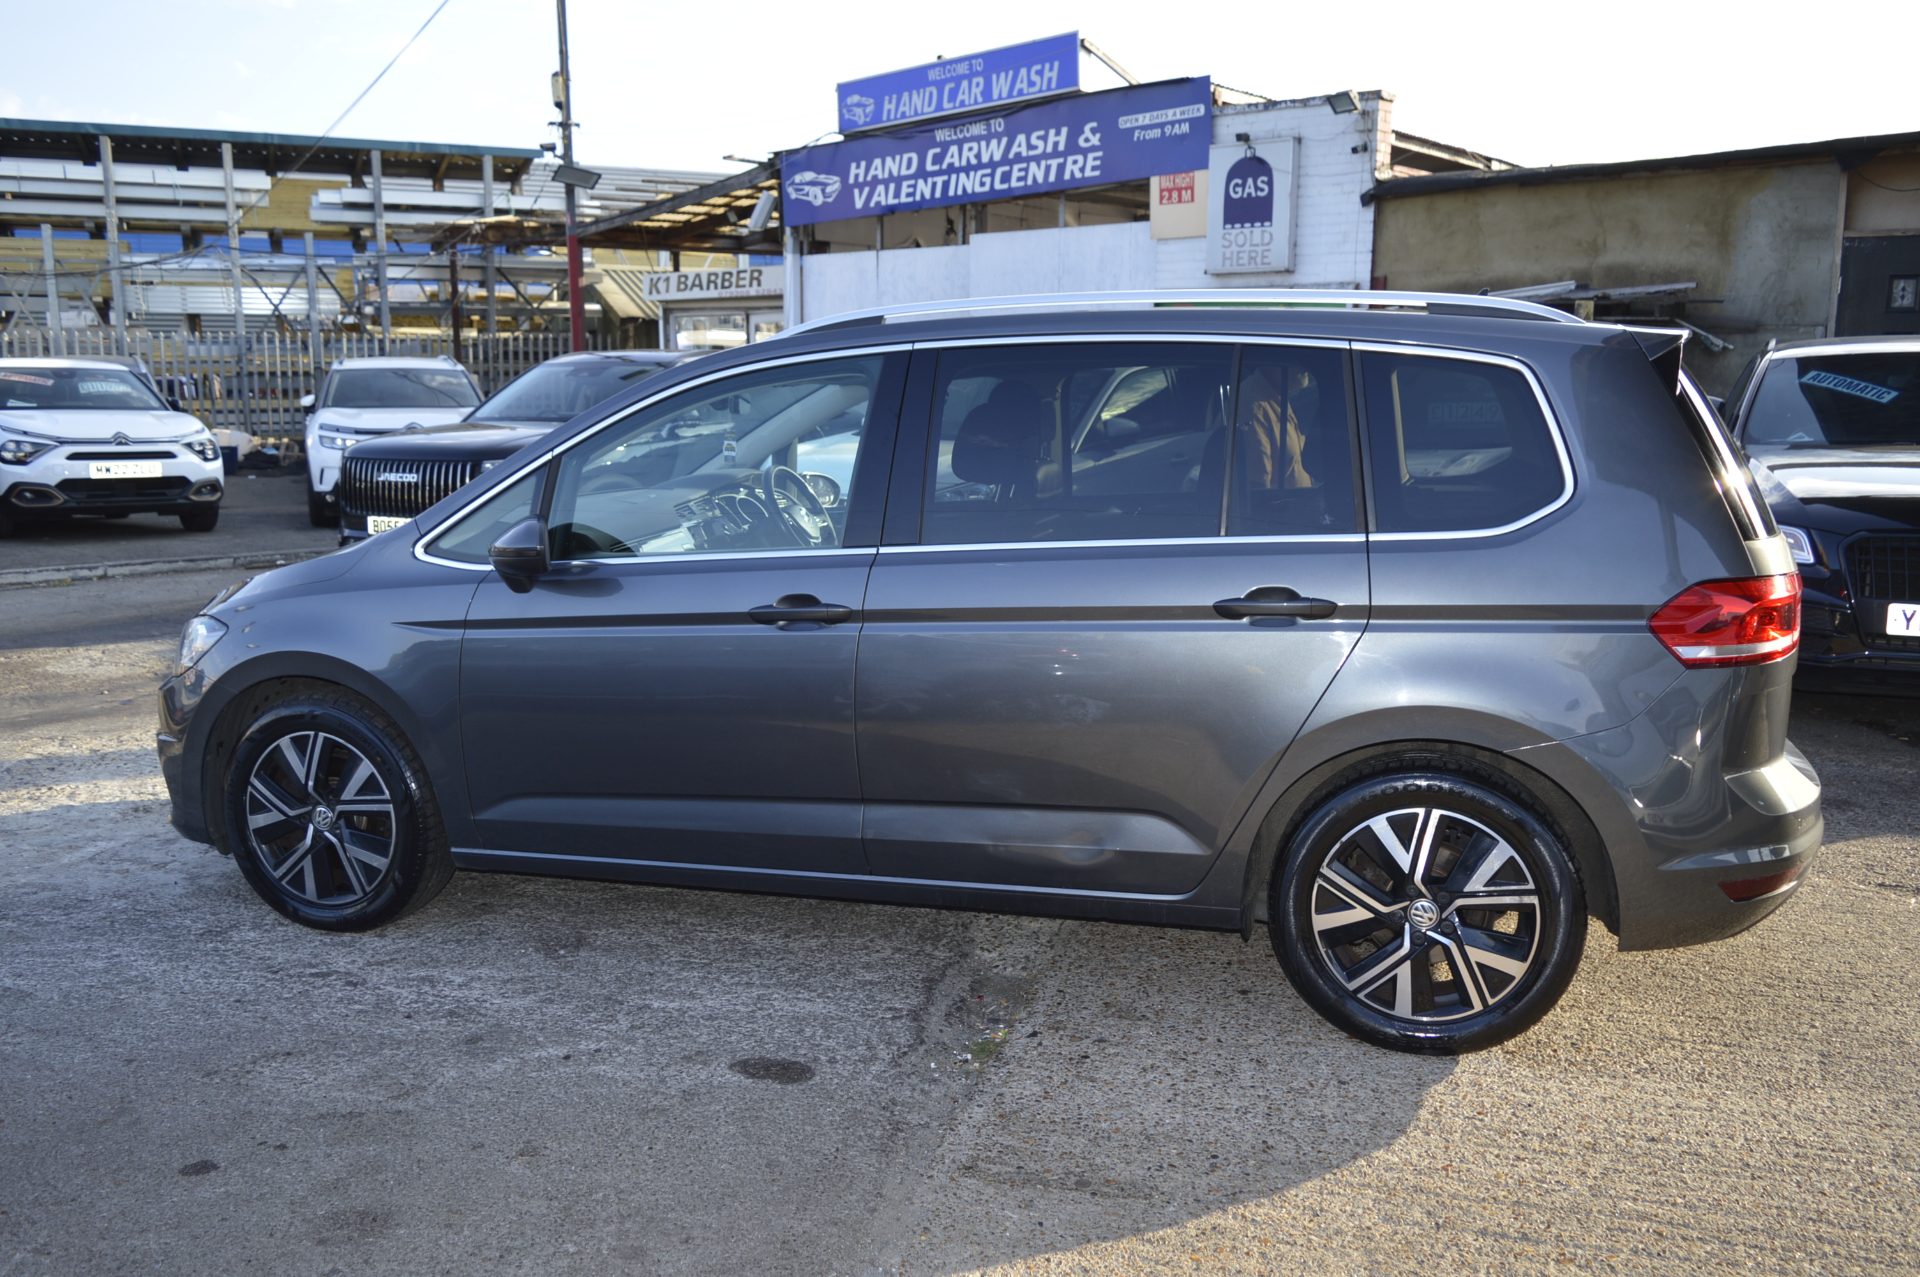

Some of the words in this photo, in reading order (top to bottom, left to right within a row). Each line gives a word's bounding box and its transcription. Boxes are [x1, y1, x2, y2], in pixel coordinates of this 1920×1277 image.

[928, 63, 970, 81] WELCOME
[972, 58, 984, 72] TO
[882, 86, 938, 121] HAND
[942, 77, 984, 109] CAR
[991, 60, 1060, 100] WASH
[1120, 117, 1139, 126] OPEN
[1149, 112, 1169, 122] DAYS
[1171, 110, 1178, 118] A
[1179, 106, 1202, 117] WEEK
[935, 120, 987, 142] WELCOME
[990, 118, 1005, 133] TO
[1133, 128, 1161, 142] From
[1164, 121, 1190, 137] 9AM
[848, 151, 919, 184] HAND
[1078, 122, 1102, 148] &
[1162, 190, 1178, 204] 2.8
[1181, 189, 1192, 203] M
[1229, 176, 1269, 199] GAS
[1222, 230, 1273, 249] SOLD
[1222, 248, 1271, 267] HERE
[648, 276, 671, 295] K1
[676, 269, 763, 292] BARBER
[1807, 372, 1893, 401] AUTOMATIC
[377, 472, 418, 482] JAECOO
